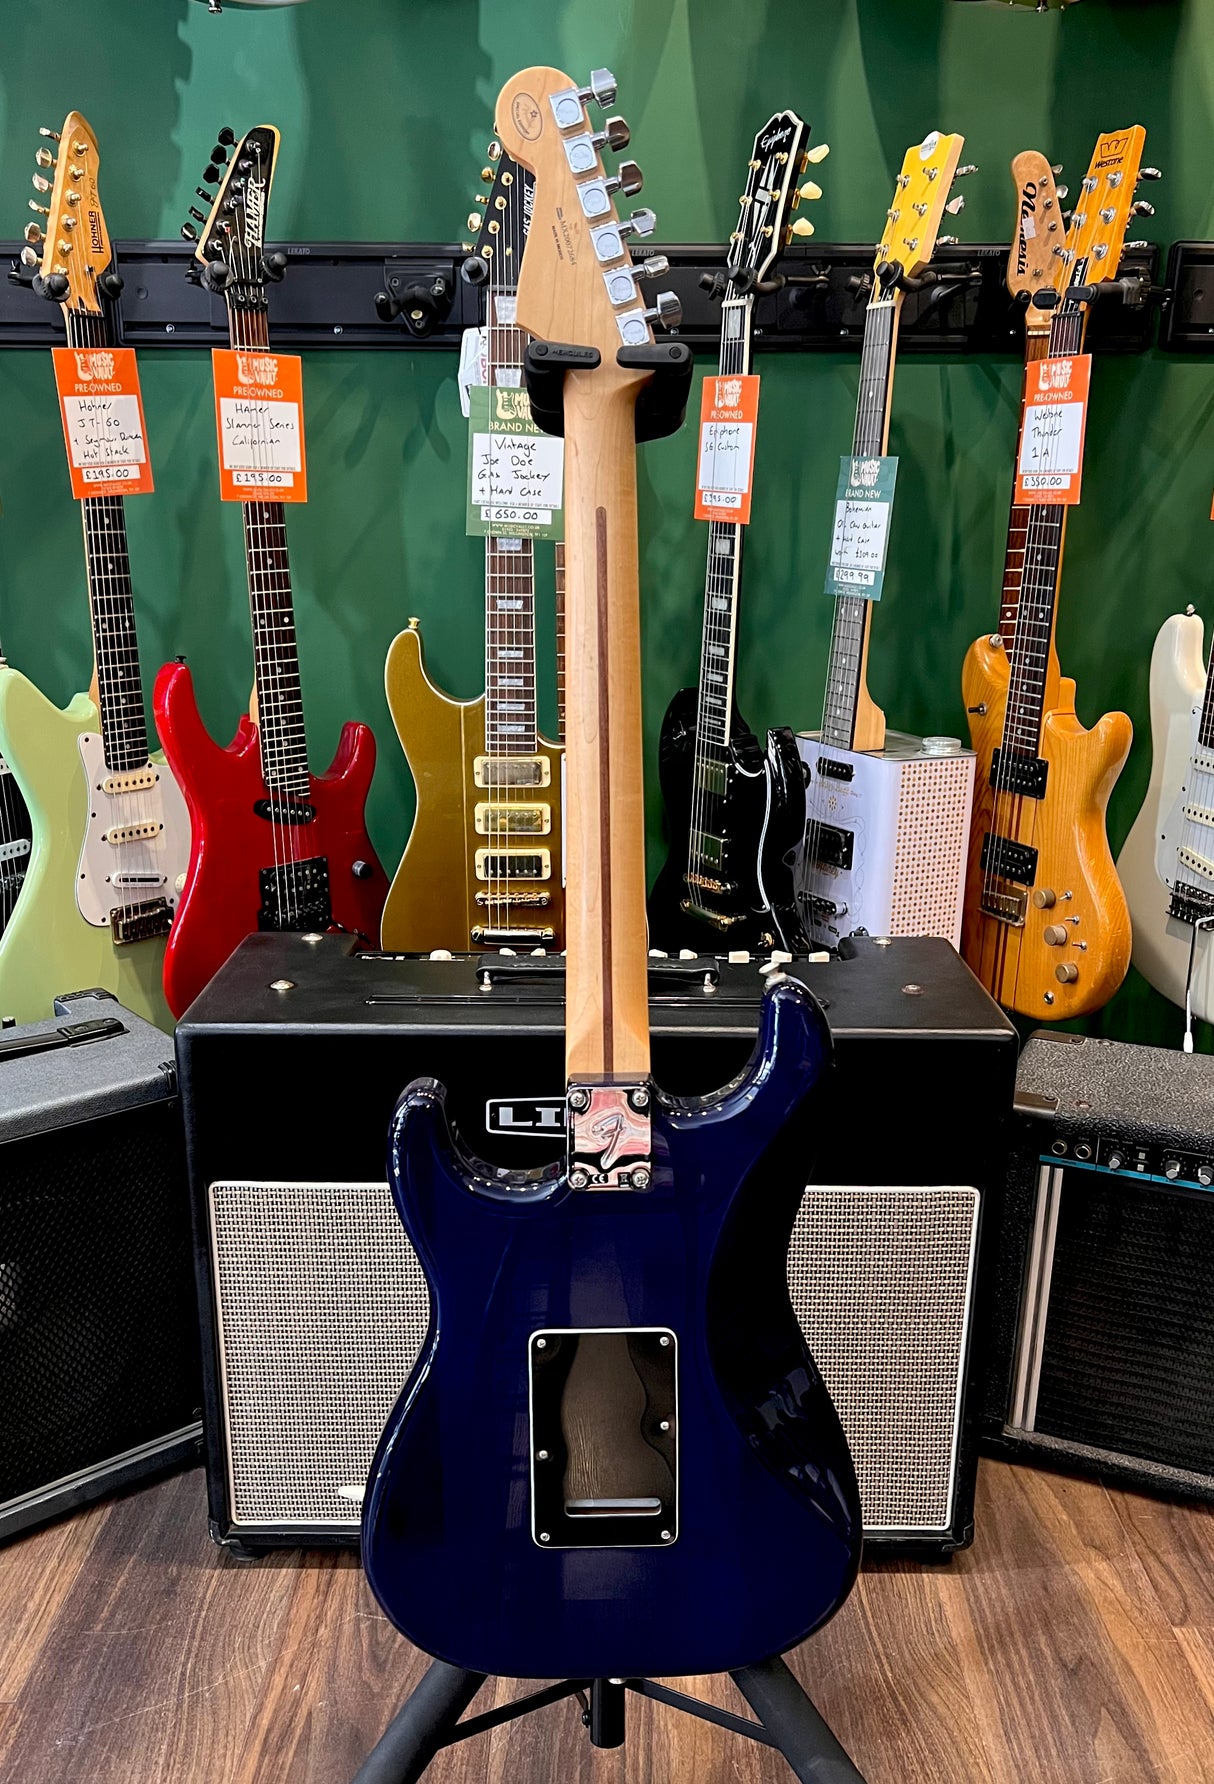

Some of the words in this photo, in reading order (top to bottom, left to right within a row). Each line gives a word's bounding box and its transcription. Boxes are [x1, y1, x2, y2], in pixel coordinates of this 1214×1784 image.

[244, 177, 267, 249] HAMER
[89, 210, 105, 254] HOHNER
[252, 356, 278, 372] MUSIC
[74, 382, 122, 394] PRE-OWNED
[1033, 390, 1074, 402] PRE-OWNED
[490, 421, 523, 433] BRAND
[525, 424, 544, 434] NE
[481, 453, 500, 466] Joe
[510, 455, 534, 467] Doe
[85, 468, 129, 480] £195.00
[236, 473, 282, 483] £195.00
[1024, 476, 1063, 487] £350.00
